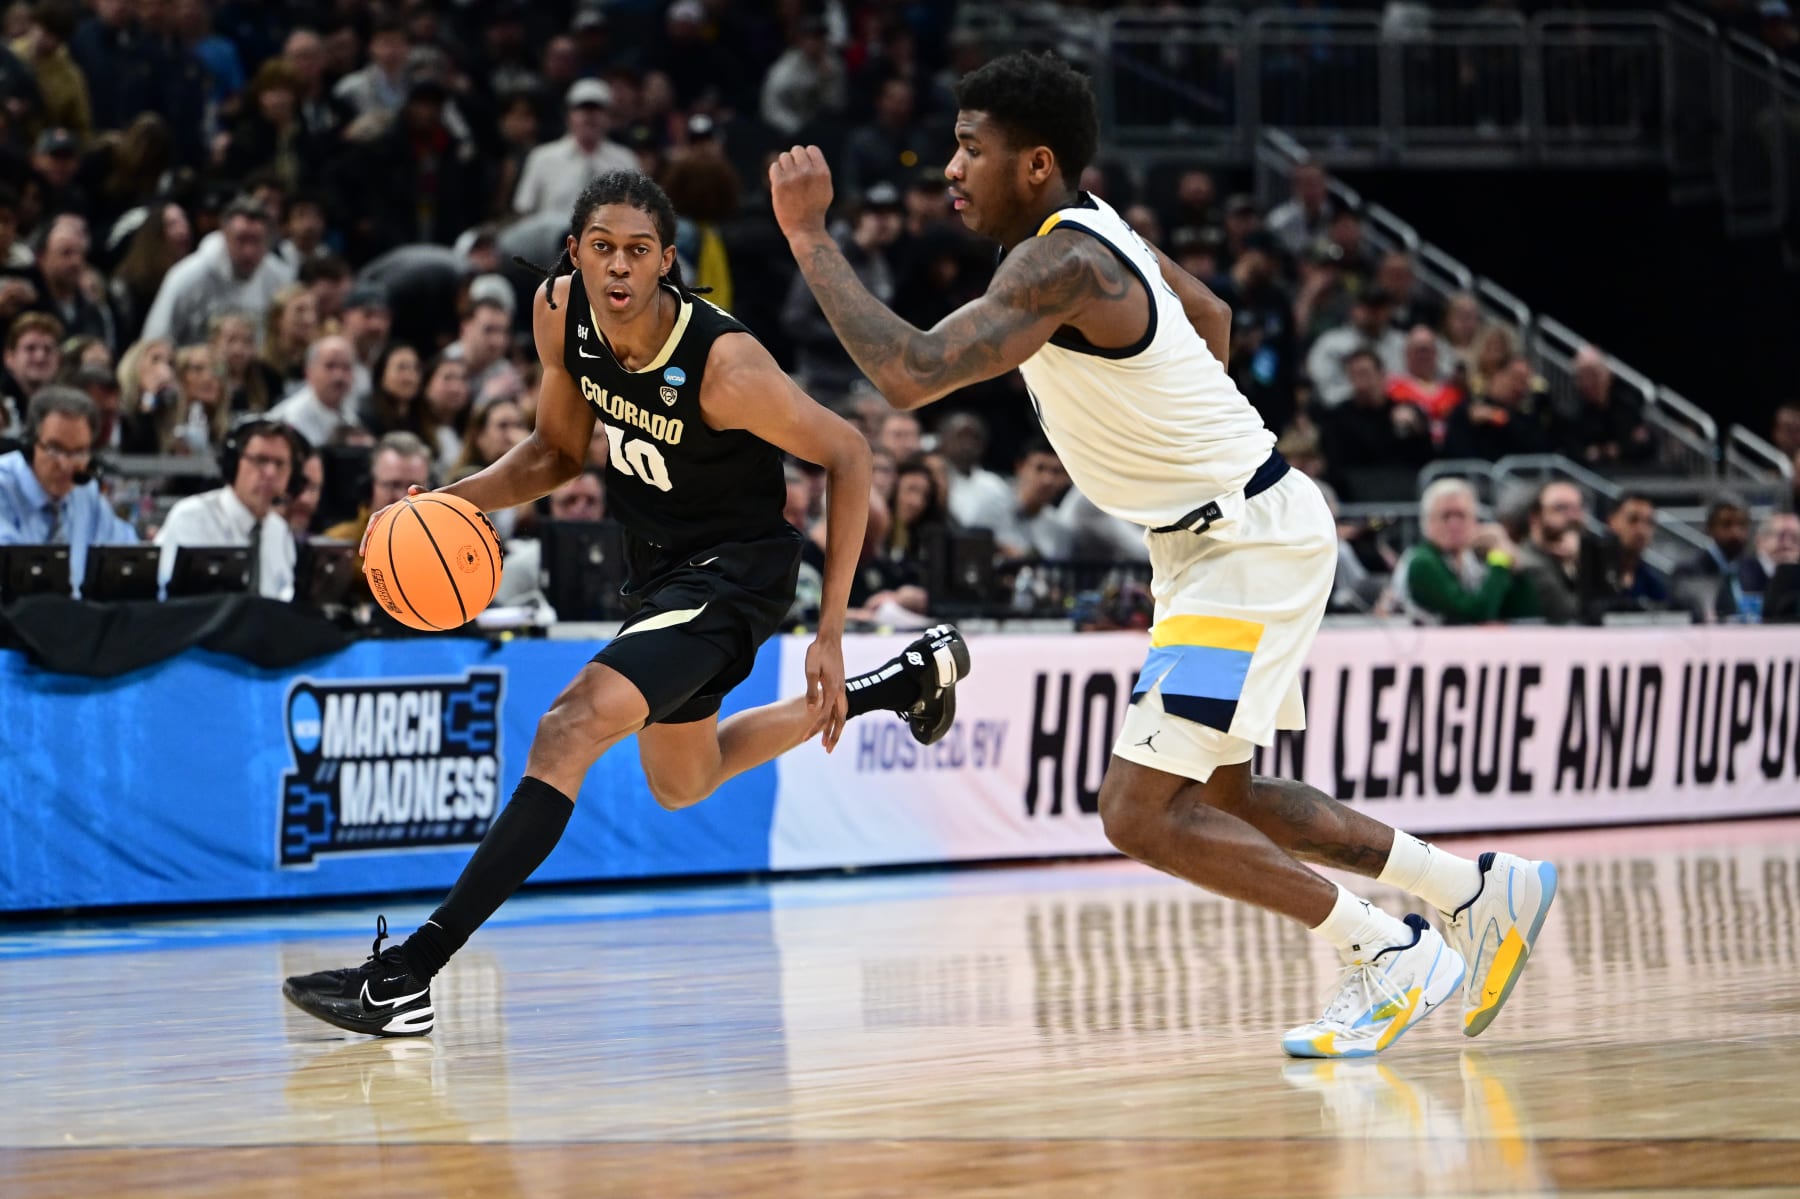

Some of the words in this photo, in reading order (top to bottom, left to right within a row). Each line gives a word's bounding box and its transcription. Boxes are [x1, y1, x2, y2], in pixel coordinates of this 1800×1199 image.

[580, 375, 684, 446] COLORADO
[604, 422, 673, 493] 10
[321, 690, 442, 758] MARCH
[1333, 664, 1541, 801] LEAGUE
[1554, 663, 1664, 793] AND
[1675, 659, 1800, 787] IUPU
[339, 755, 497, 827] MADNESS
